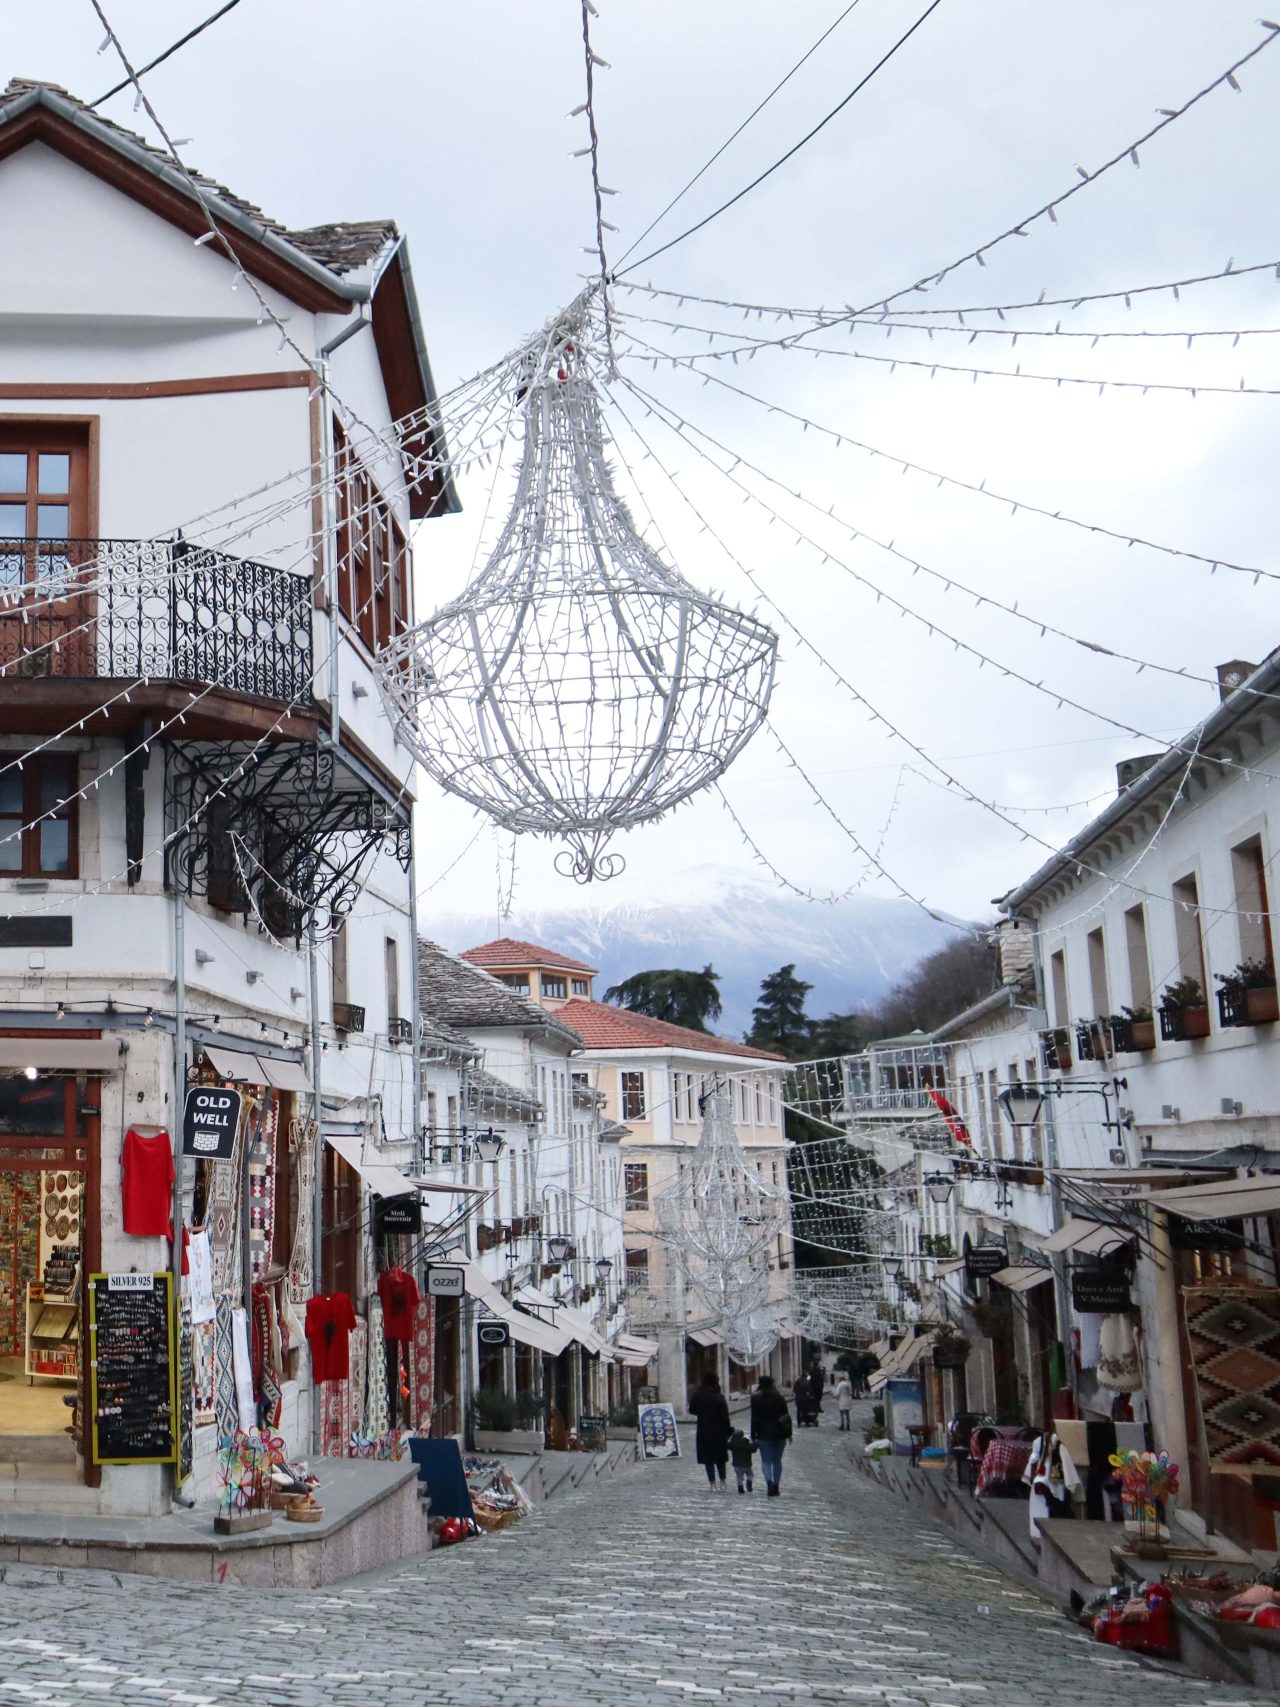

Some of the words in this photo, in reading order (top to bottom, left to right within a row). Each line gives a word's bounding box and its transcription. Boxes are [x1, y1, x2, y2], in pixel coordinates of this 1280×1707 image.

[196, 1095, 231, 1109] OLD
[193, 1112, 229, 1127] WELL
[111, 1276, 137, 1286] SILVER
[138, 1276, 151, 1286] 925
